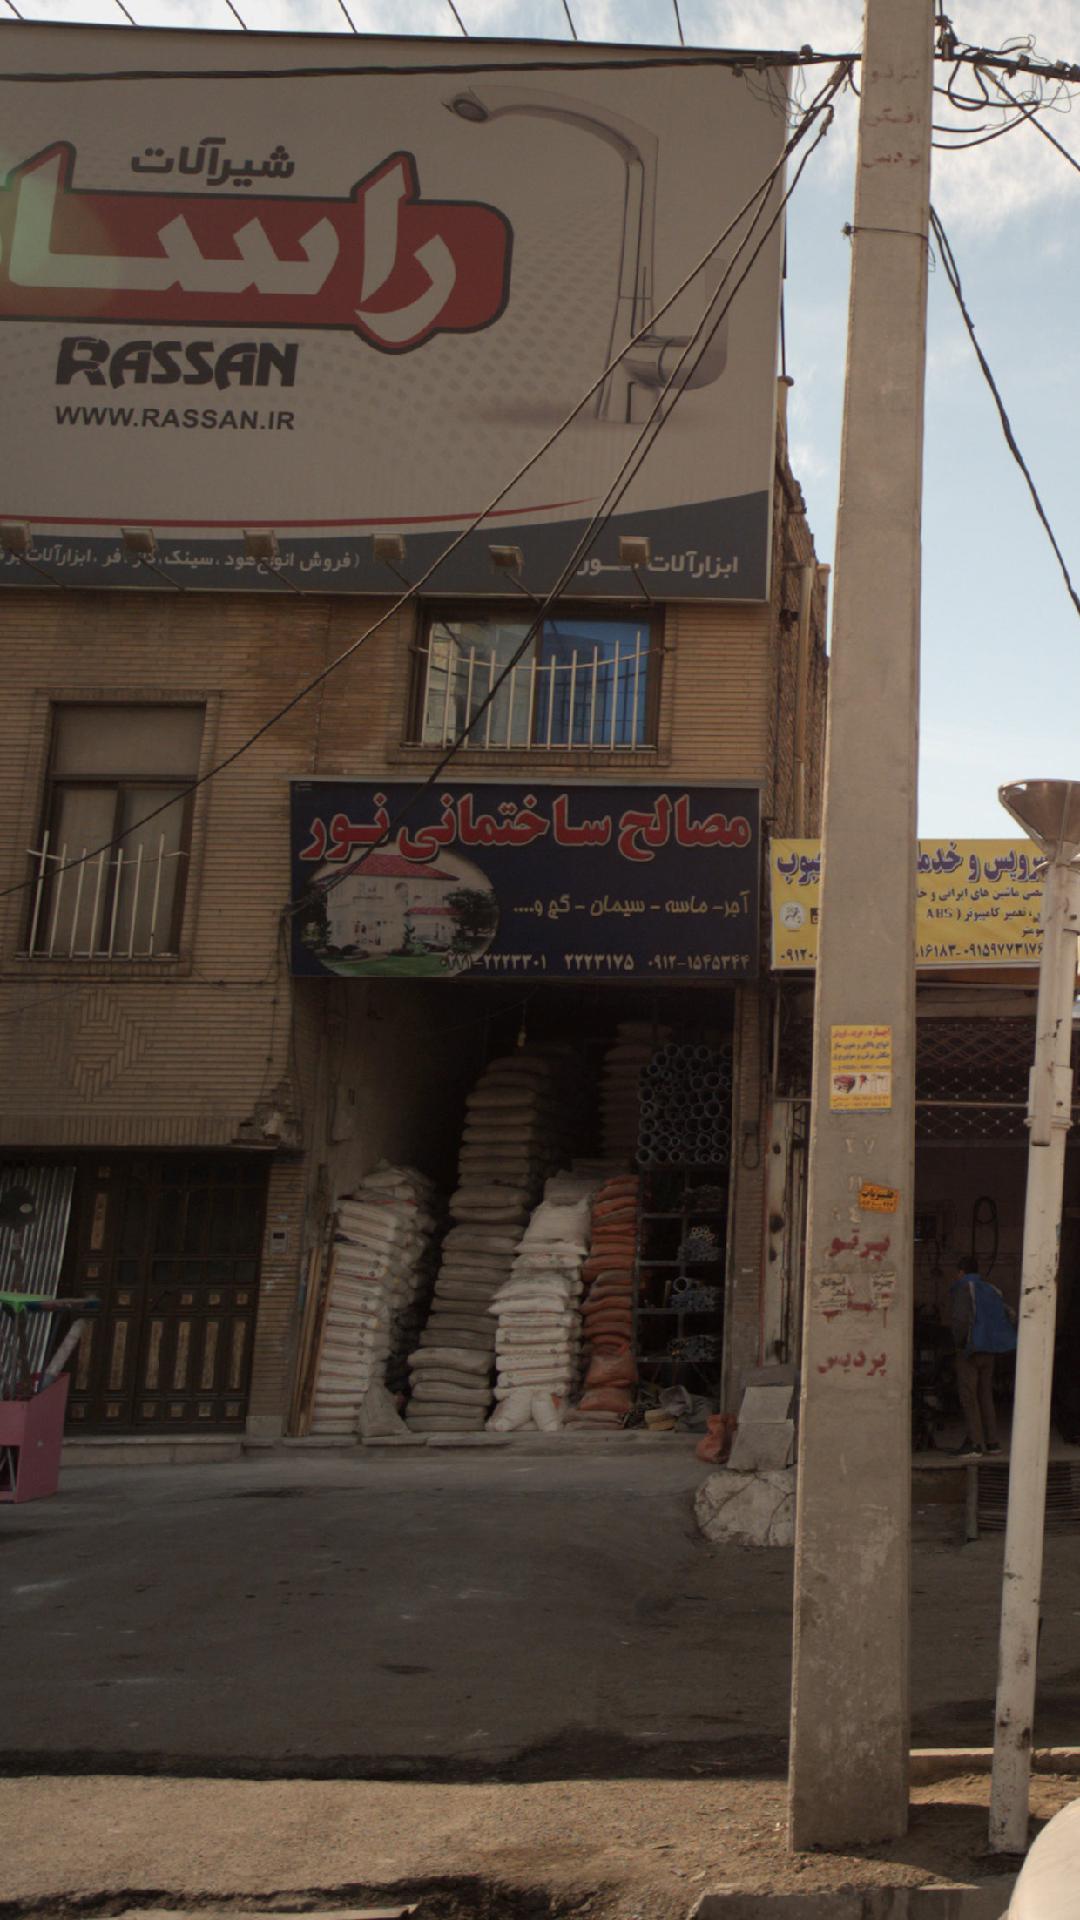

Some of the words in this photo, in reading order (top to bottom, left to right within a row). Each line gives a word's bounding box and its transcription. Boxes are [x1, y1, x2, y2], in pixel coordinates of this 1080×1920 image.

[131, 137, 295, 187] شیرآلات
[0, 152, 457, 344] راسا
[56, 337, 299, 390] RASSAN
[56, 406, 294, 430] WWW.RASSAN.IR
[299, 792, 391, 861] نور
[398, 792, 612, 862] ساختمانی
[617, 793, 752, 862] مصالح
[590, 895, 646, 917] سیمان
